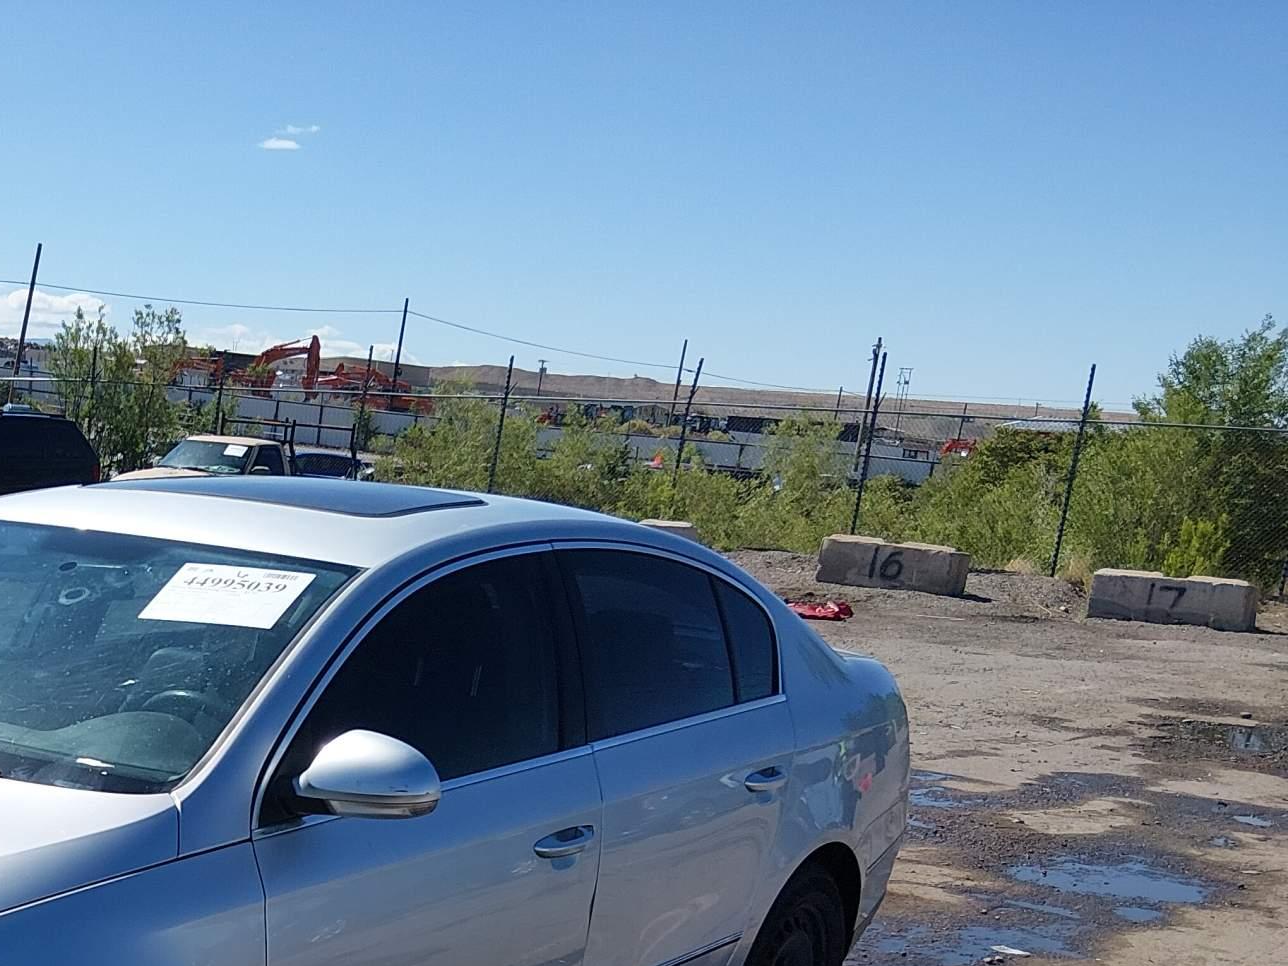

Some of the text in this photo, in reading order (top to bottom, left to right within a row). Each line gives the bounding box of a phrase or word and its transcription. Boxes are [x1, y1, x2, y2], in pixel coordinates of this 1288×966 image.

[869, 547, 905, 580] 16
[183, 576, 288, 593] 44995039
[1149, 583, 1187, 609] 17
